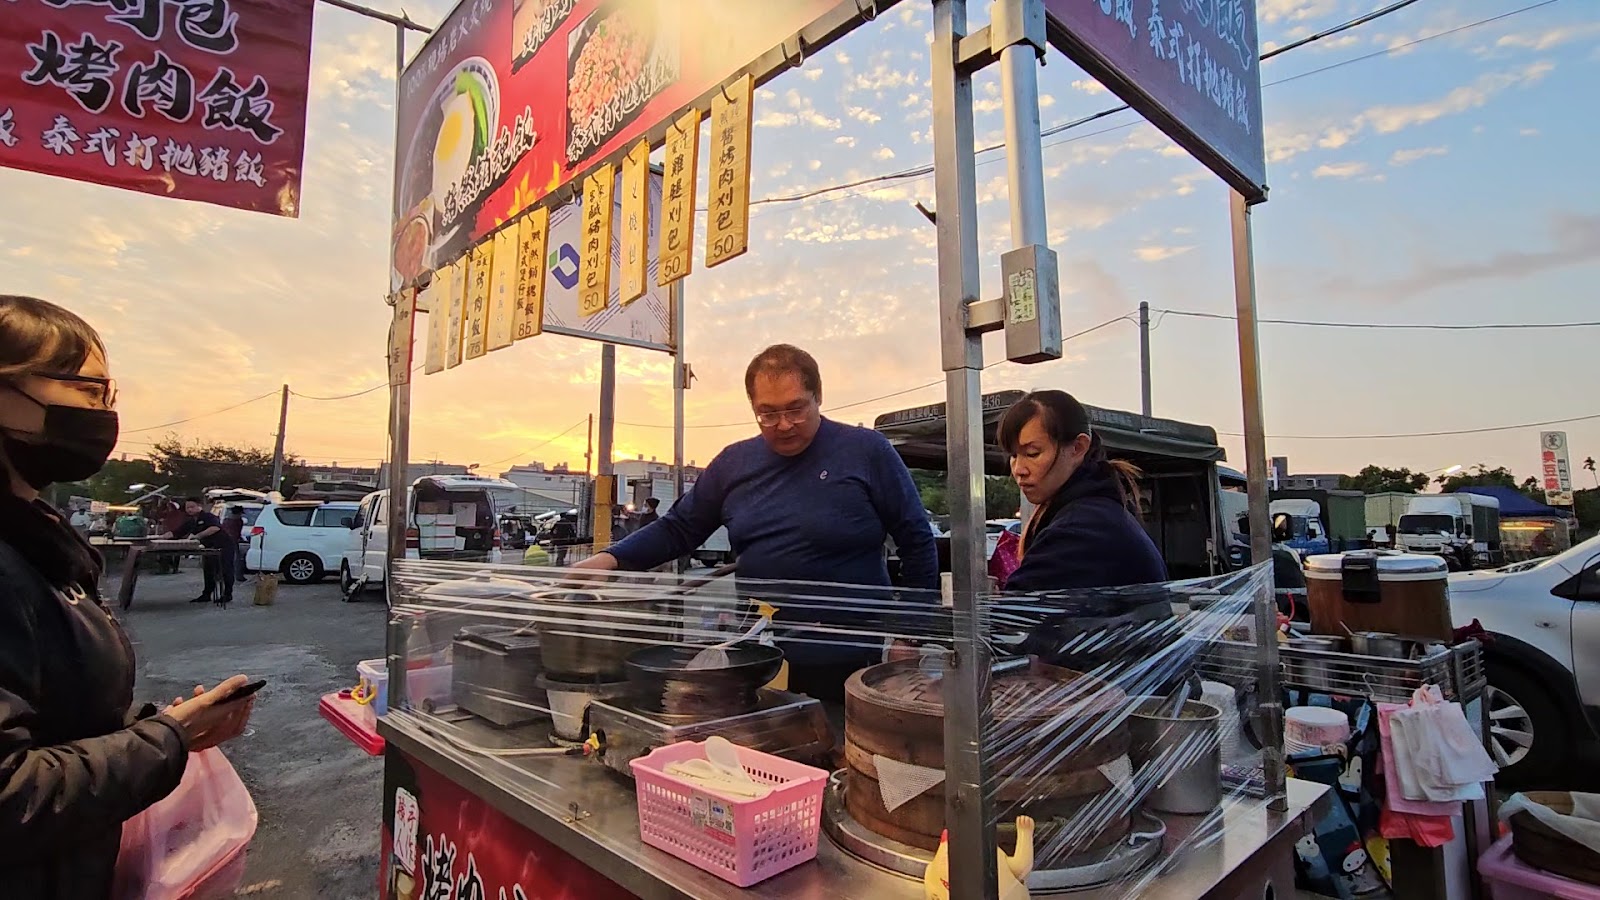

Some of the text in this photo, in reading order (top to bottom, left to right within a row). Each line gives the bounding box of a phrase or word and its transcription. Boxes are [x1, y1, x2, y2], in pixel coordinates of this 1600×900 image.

[21, 31, 284, 145] 烤肉飯
[713, 234, 734, 258] 50
[664, 256, 680, 278] 50
[584, 291, 599, 310] 50
[518, 321, 532, 337] 85
[469, 341, 481, 354] 75
